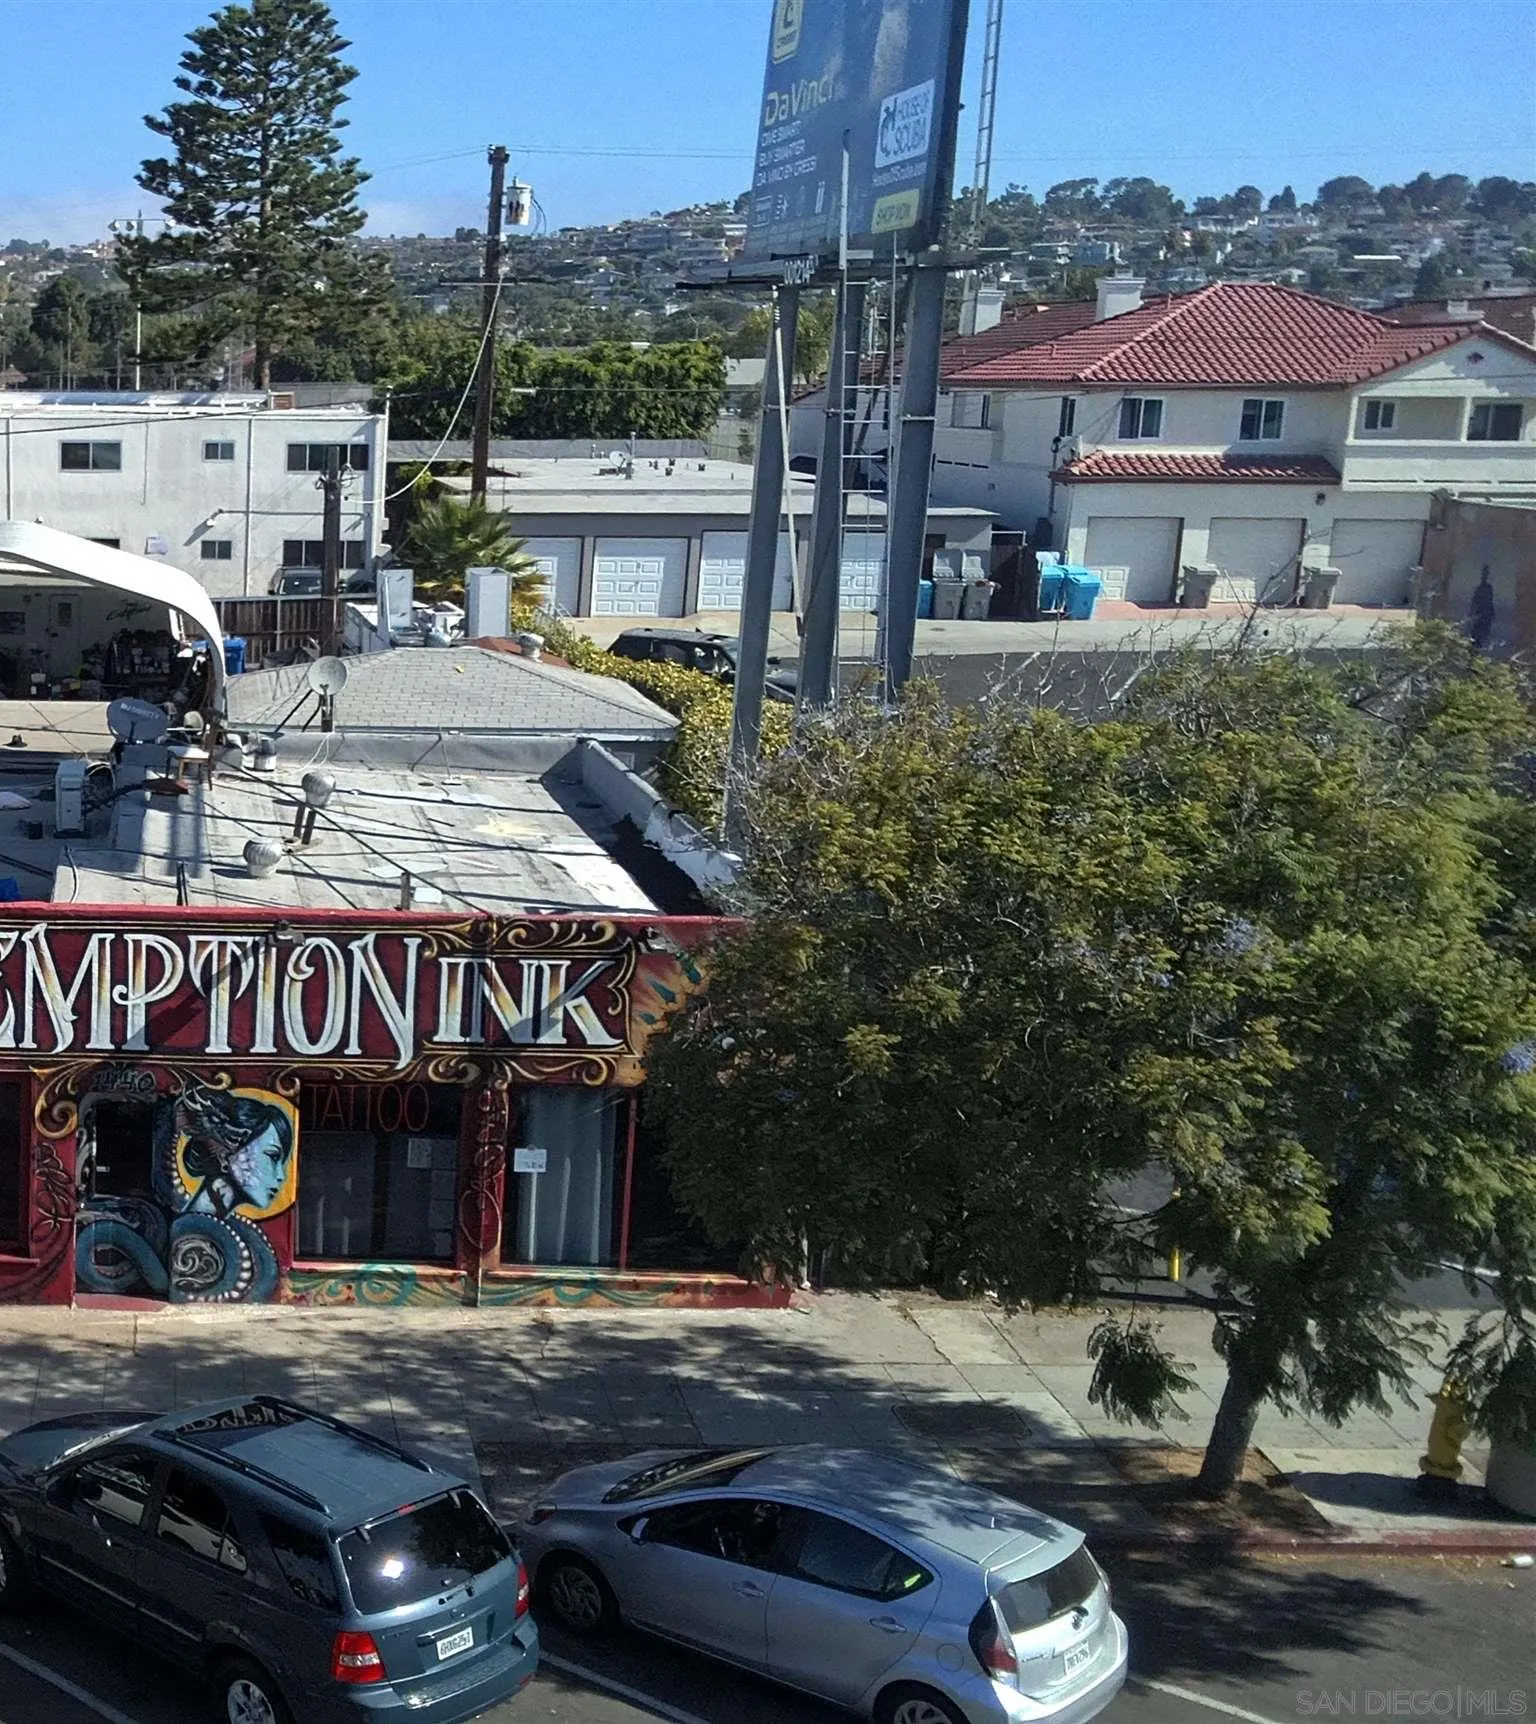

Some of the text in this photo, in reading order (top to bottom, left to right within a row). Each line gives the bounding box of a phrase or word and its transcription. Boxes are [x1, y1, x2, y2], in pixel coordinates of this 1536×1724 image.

[765, 77, 834, 127] DaVinci
[432, 957, 627, 1046] INK
[303, 1083, 429, 1132] TATTOO
